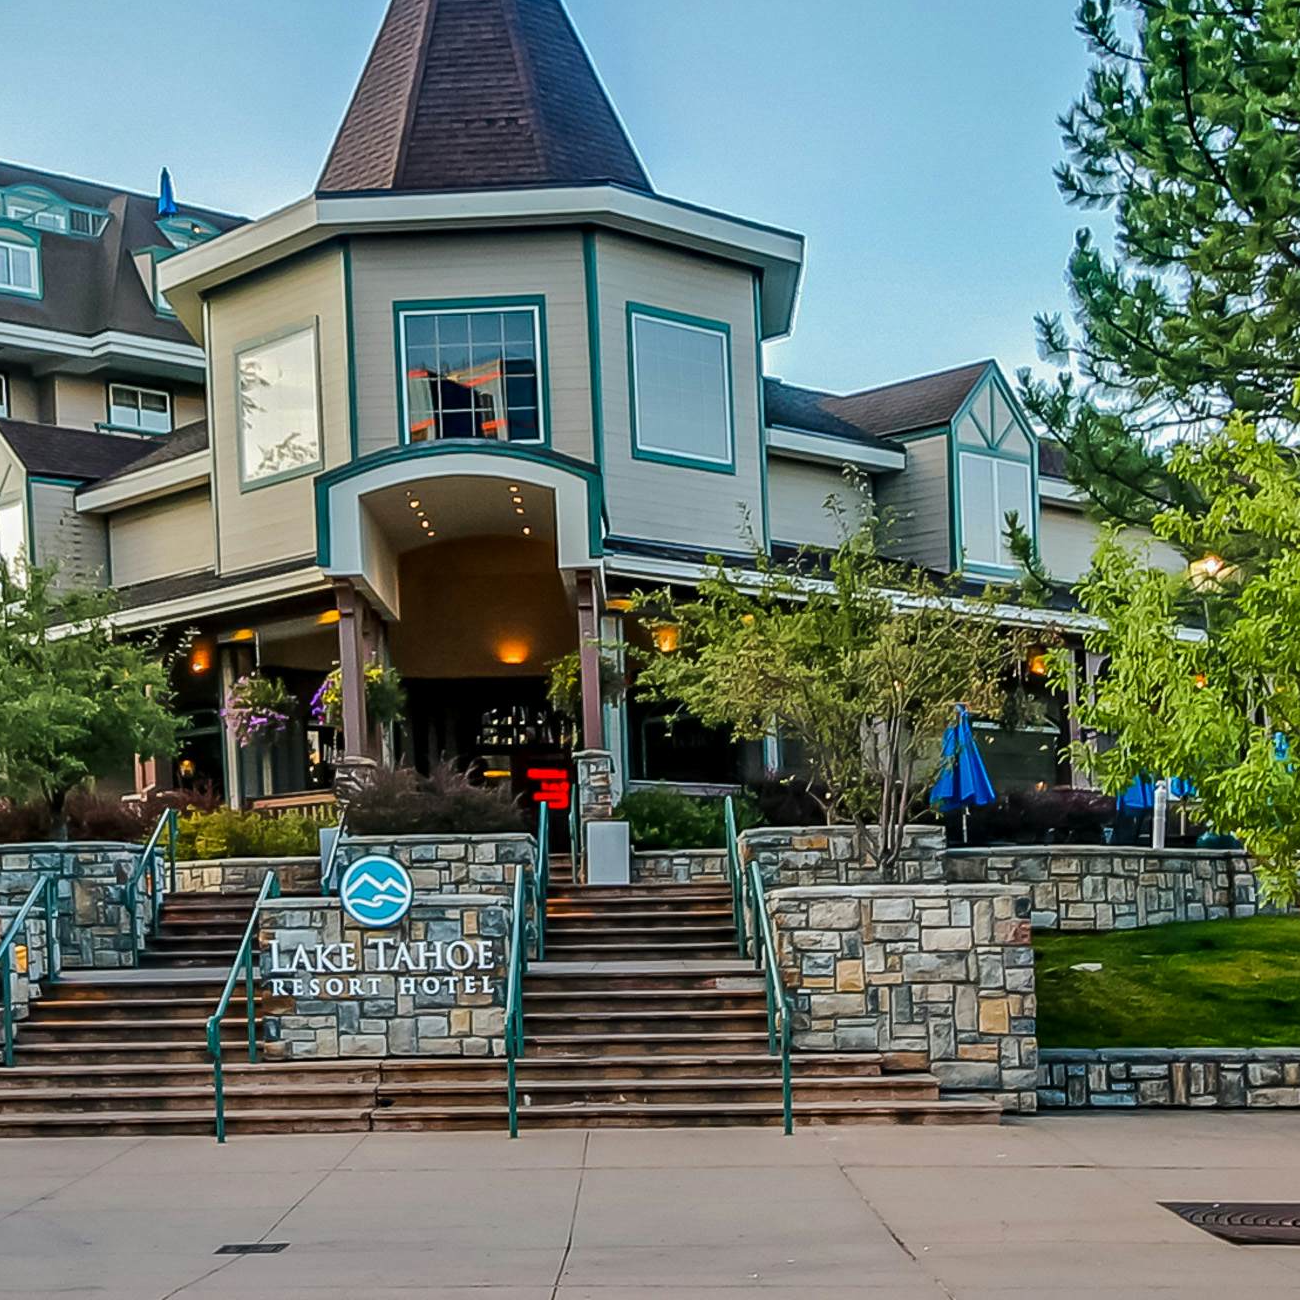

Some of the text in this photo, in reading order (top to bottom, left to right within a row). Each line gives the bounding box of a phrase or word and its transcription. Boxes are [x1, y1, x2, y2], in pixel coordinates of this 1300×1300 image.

[269, 937, 496, 973] LAKE TAHOE
[271, 975, 496, 997] RESORT HOTEL
